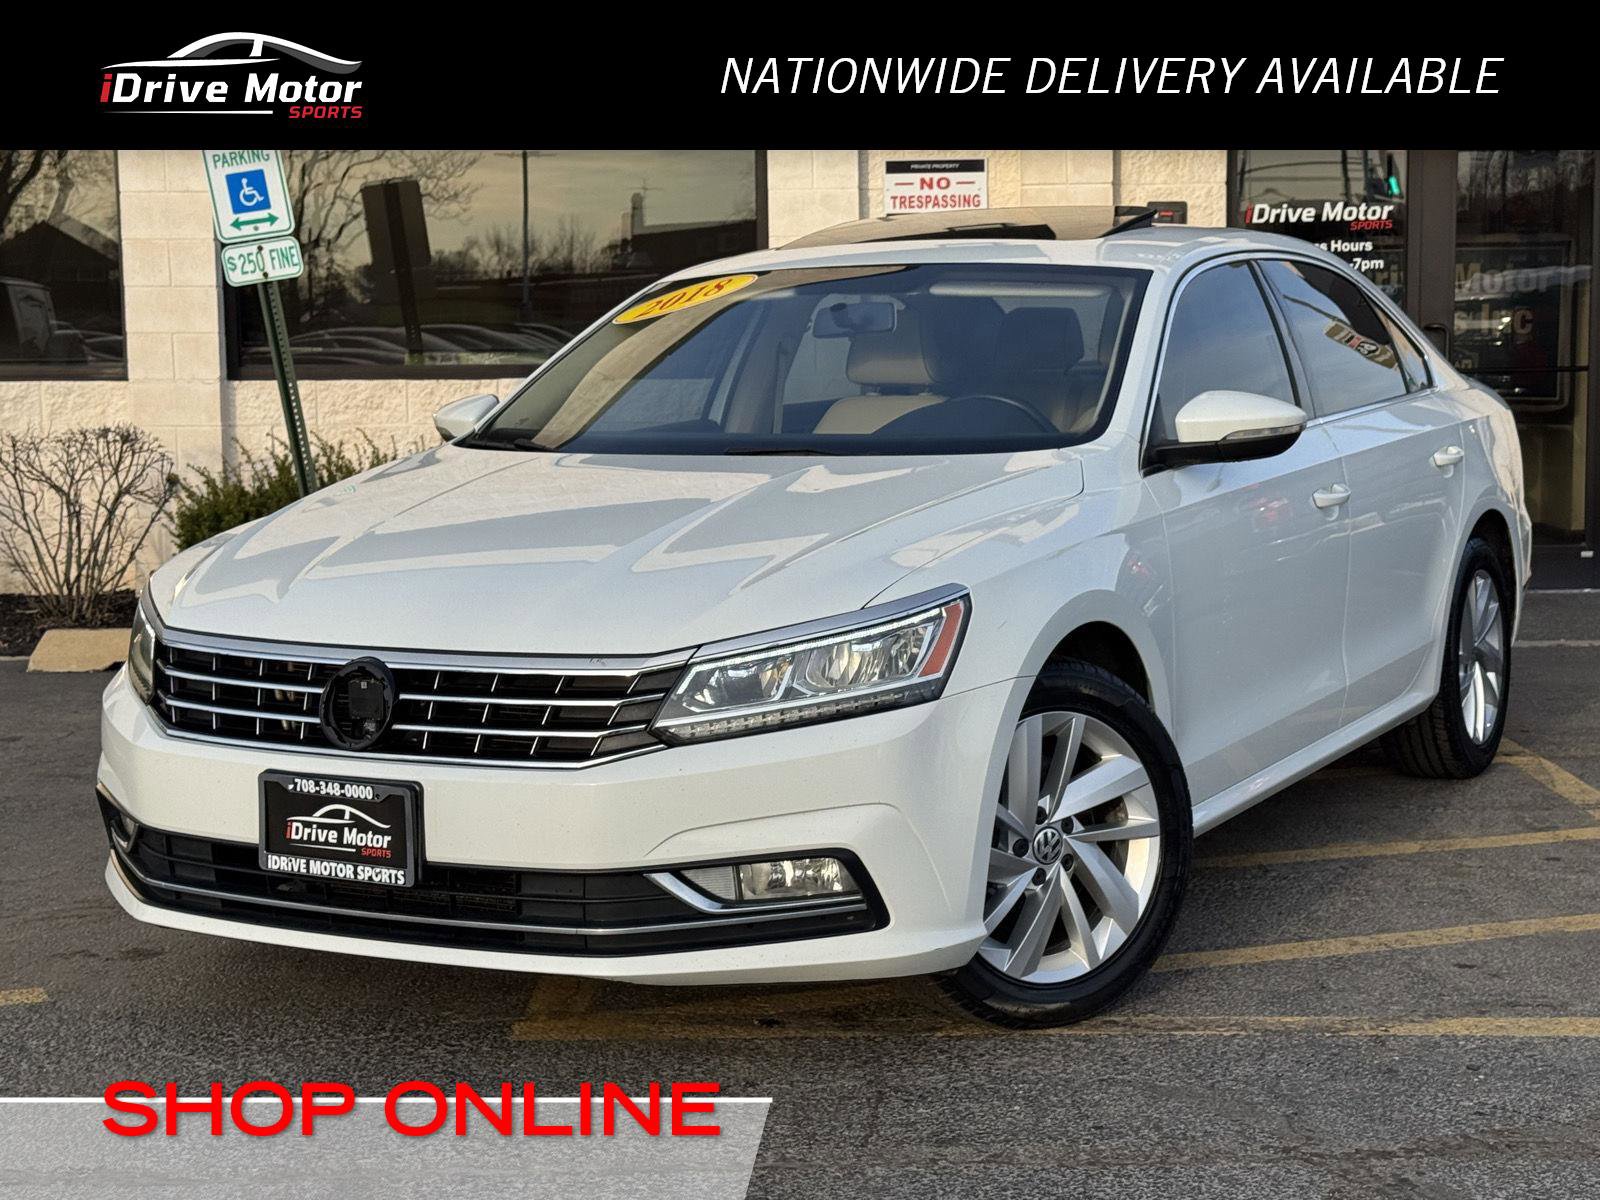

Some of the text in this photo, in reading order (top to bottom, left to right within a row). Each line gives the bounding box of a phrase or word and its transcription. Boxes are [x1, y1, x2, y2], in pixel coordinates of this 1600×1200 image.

[212, 149, 271, 169] PARKING
[919, 176, 951, 190] NO
[890, 194, 981, 209] TRESPASSING
[1245, 201, 1394, 224] iDrive Motor
[1350, 219, 1393, 231] SPORTS
[1330, 239, 1373, 252] Hours
[227, 245, 298, 275] $250 FINE
[634, 278, 732, 319] 2018
[294, 778, 373, 800] 708-348-0000
[285, 820, 391, 849] iDrive Motor
[361, 847, 391, 859] SPORTS
[309, 861, 355, 880] MOTOR
[356, 864, 405, 885] SPORTS
